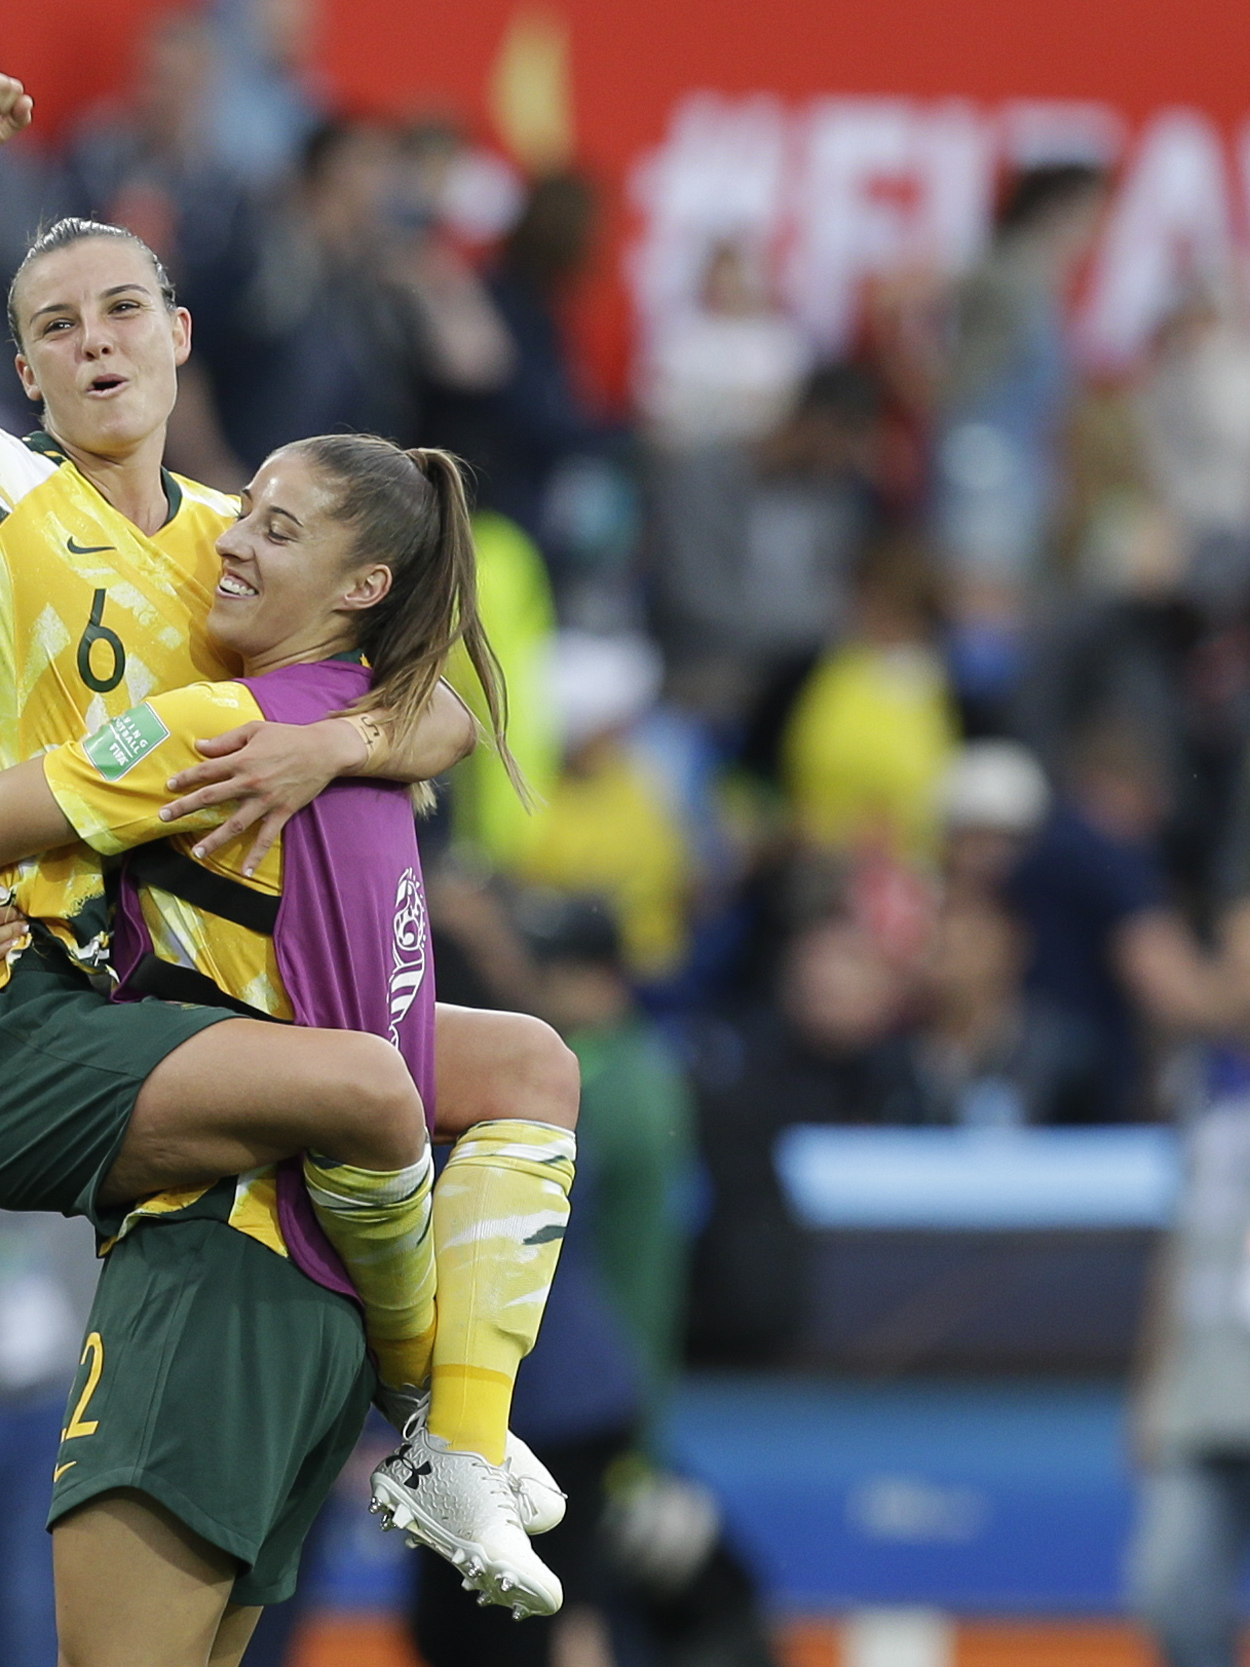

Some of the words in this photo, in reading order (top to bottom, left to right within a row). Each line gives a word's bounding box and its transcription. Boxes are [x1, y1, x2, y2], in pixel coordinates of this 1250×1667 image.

[77, 588, 126, 692] 6
[109, 742, 130, 766] FIFA
[60, 1331, 104, 1443] 2
